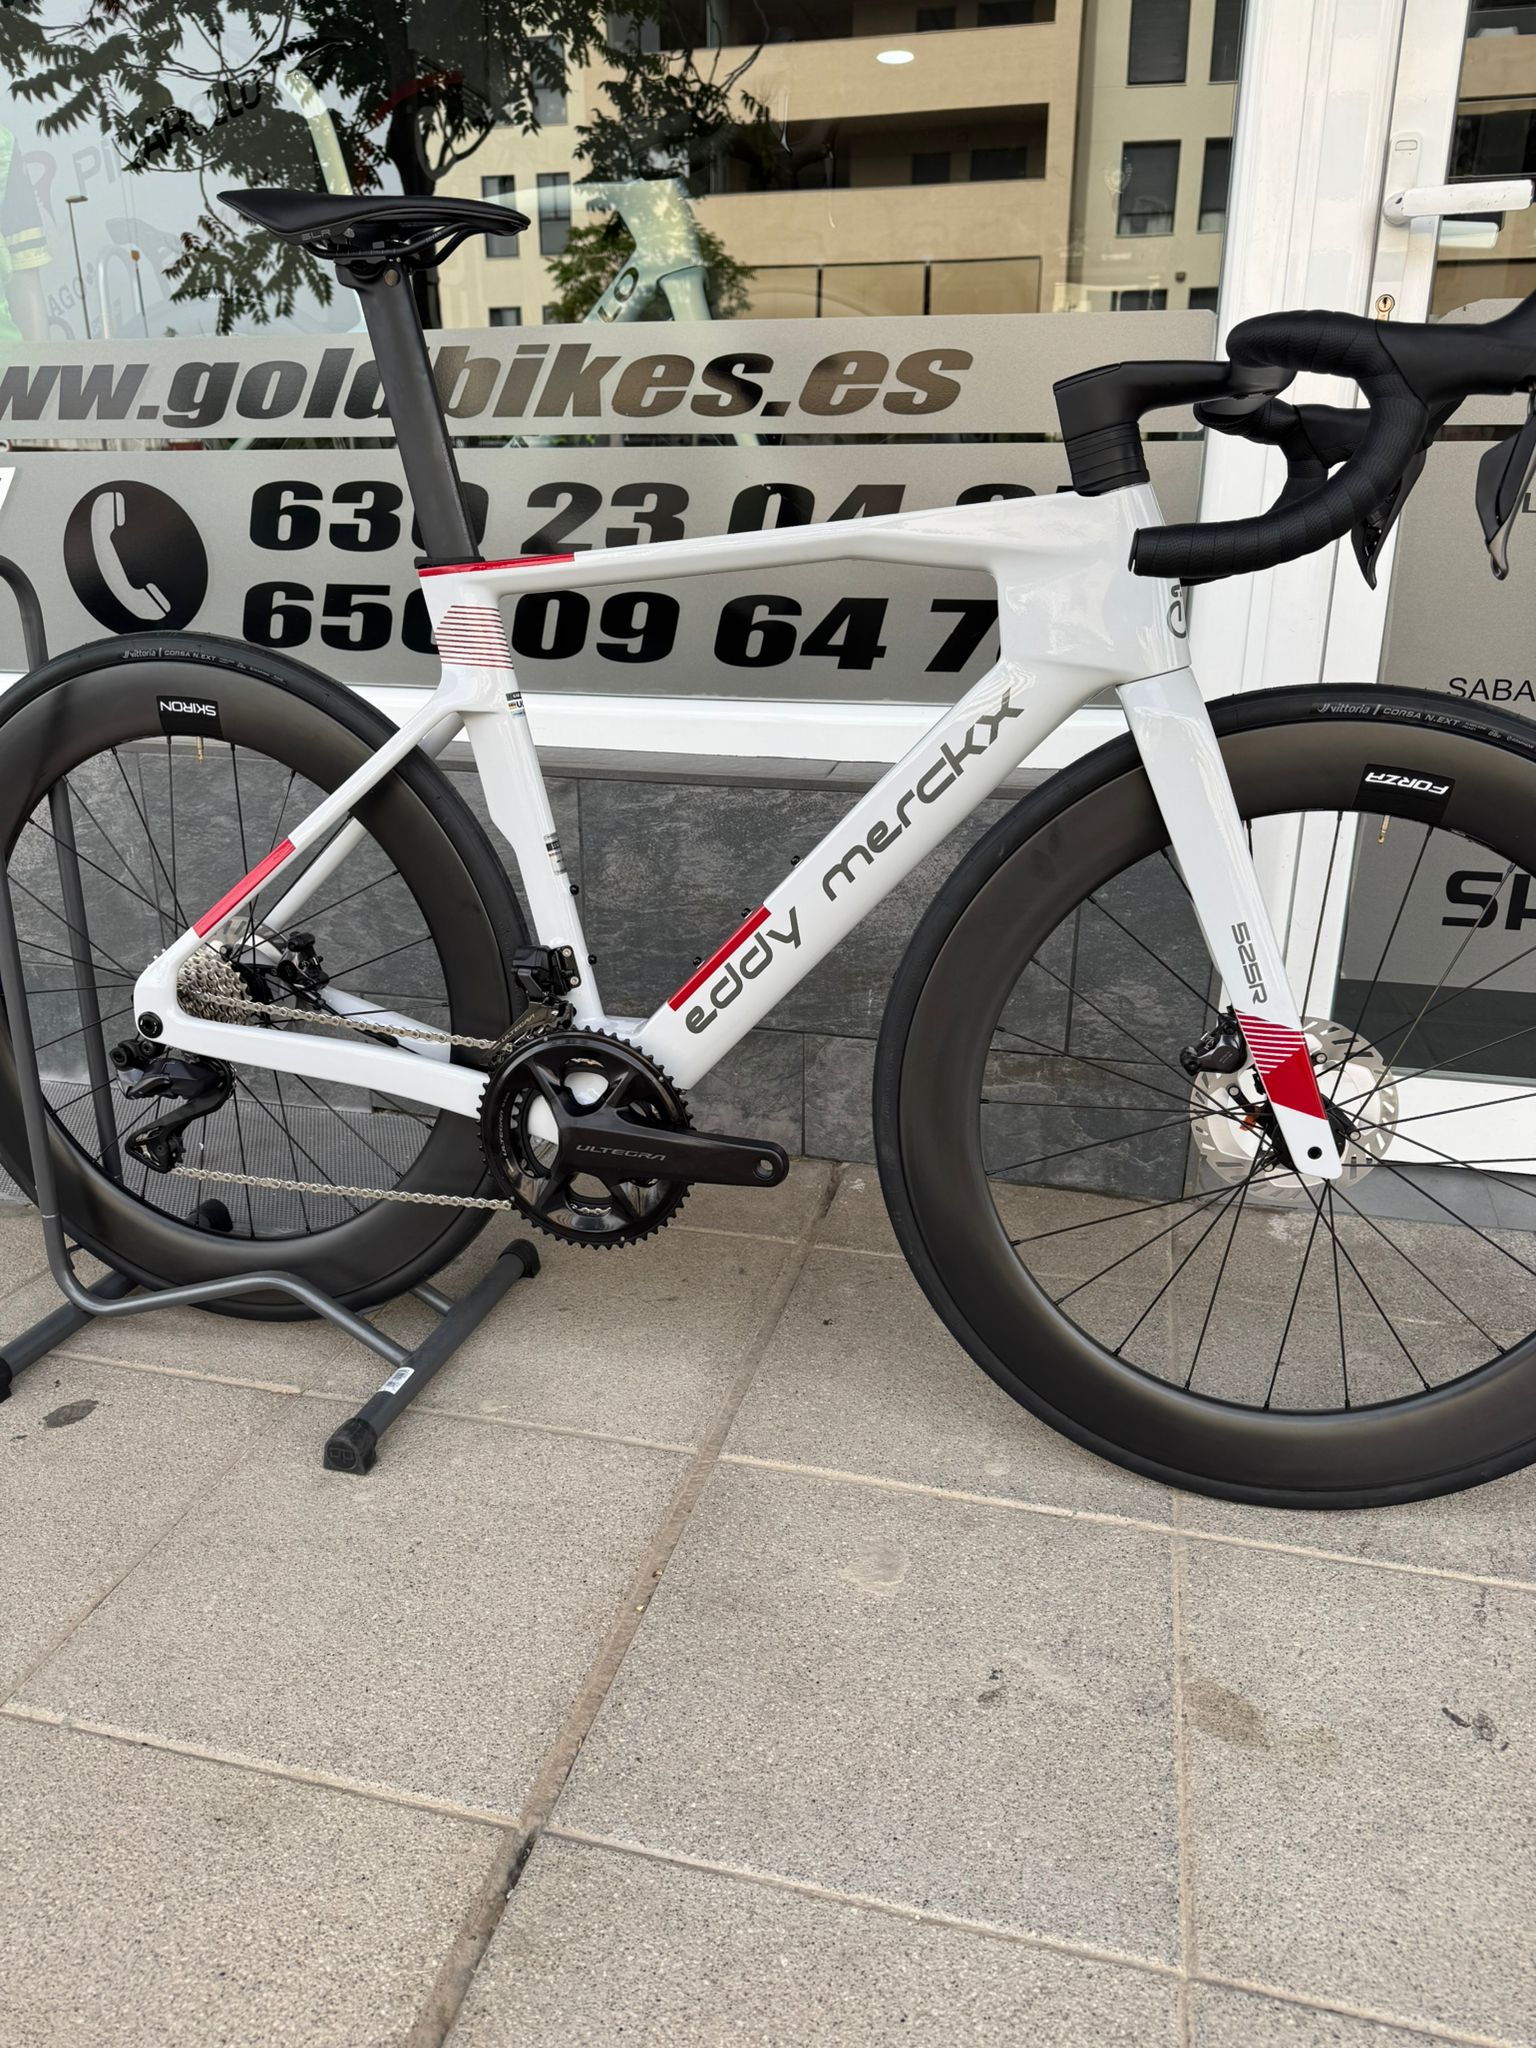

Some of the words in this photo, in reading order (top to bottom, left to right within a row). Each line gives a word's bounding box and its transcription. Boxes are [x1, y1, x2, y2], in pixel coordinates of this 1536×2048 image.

[521, 482, 689, 554] 23
[512, 590, 680, 663] 09
[714, 594, 887, 670] 64
[924, 599, 1000, 673] 7
[129, 648, 156, 658] vittoria
[164, 650, 191, 658] CORSA
[160, 701, 217, 717] SKIRON
[1329, 703, 1370, 714] vittoria
[1383, 707, 1422, 719] CORSA
[1365, 772, 1450, 795] FORZA
[685, 906, 802, 1035] eddy
[822, 687, 1024, 901] merckx
[1231, 921, 1268, 1004] 525R
[501, 1014, 535, 1043] ULTEGRA
[575, 1144, 667, 1161] ULTEGRA
